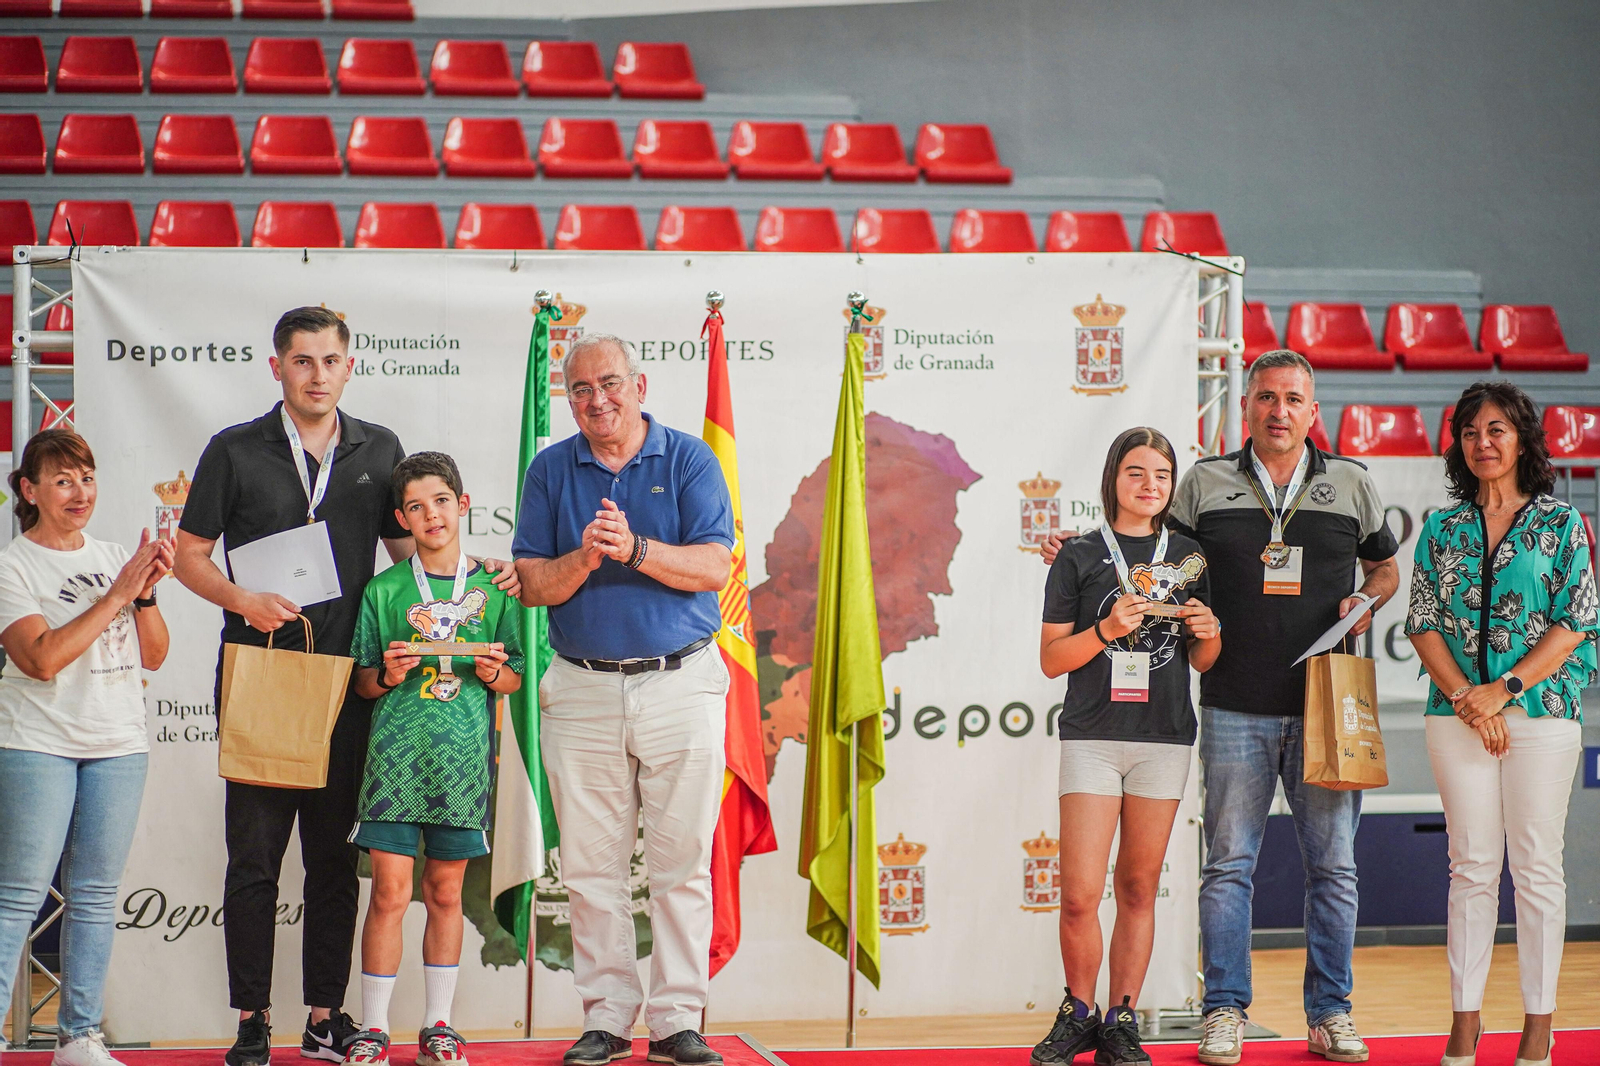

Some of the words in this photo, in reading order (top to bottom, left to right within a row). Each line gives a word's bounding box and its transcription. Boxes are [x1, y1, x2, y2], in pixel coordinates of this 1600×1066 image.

[354, 333, 460, 354] Diputación
[894, 328, 994, 349] Diputación
[107, 339, 253, 367] Deportes
[625, 340, 774, 361] EPOTES
[354, 359, 375, 376] de
[381, 359, 460, 376] Granada
[894, 354, 914, 370] de
[920, 353, 994, 370] Granada
[59, 572, 115, 604] WANT
[156, 725, 178, 742] de
[115, 887, 304, 942] Depoes
